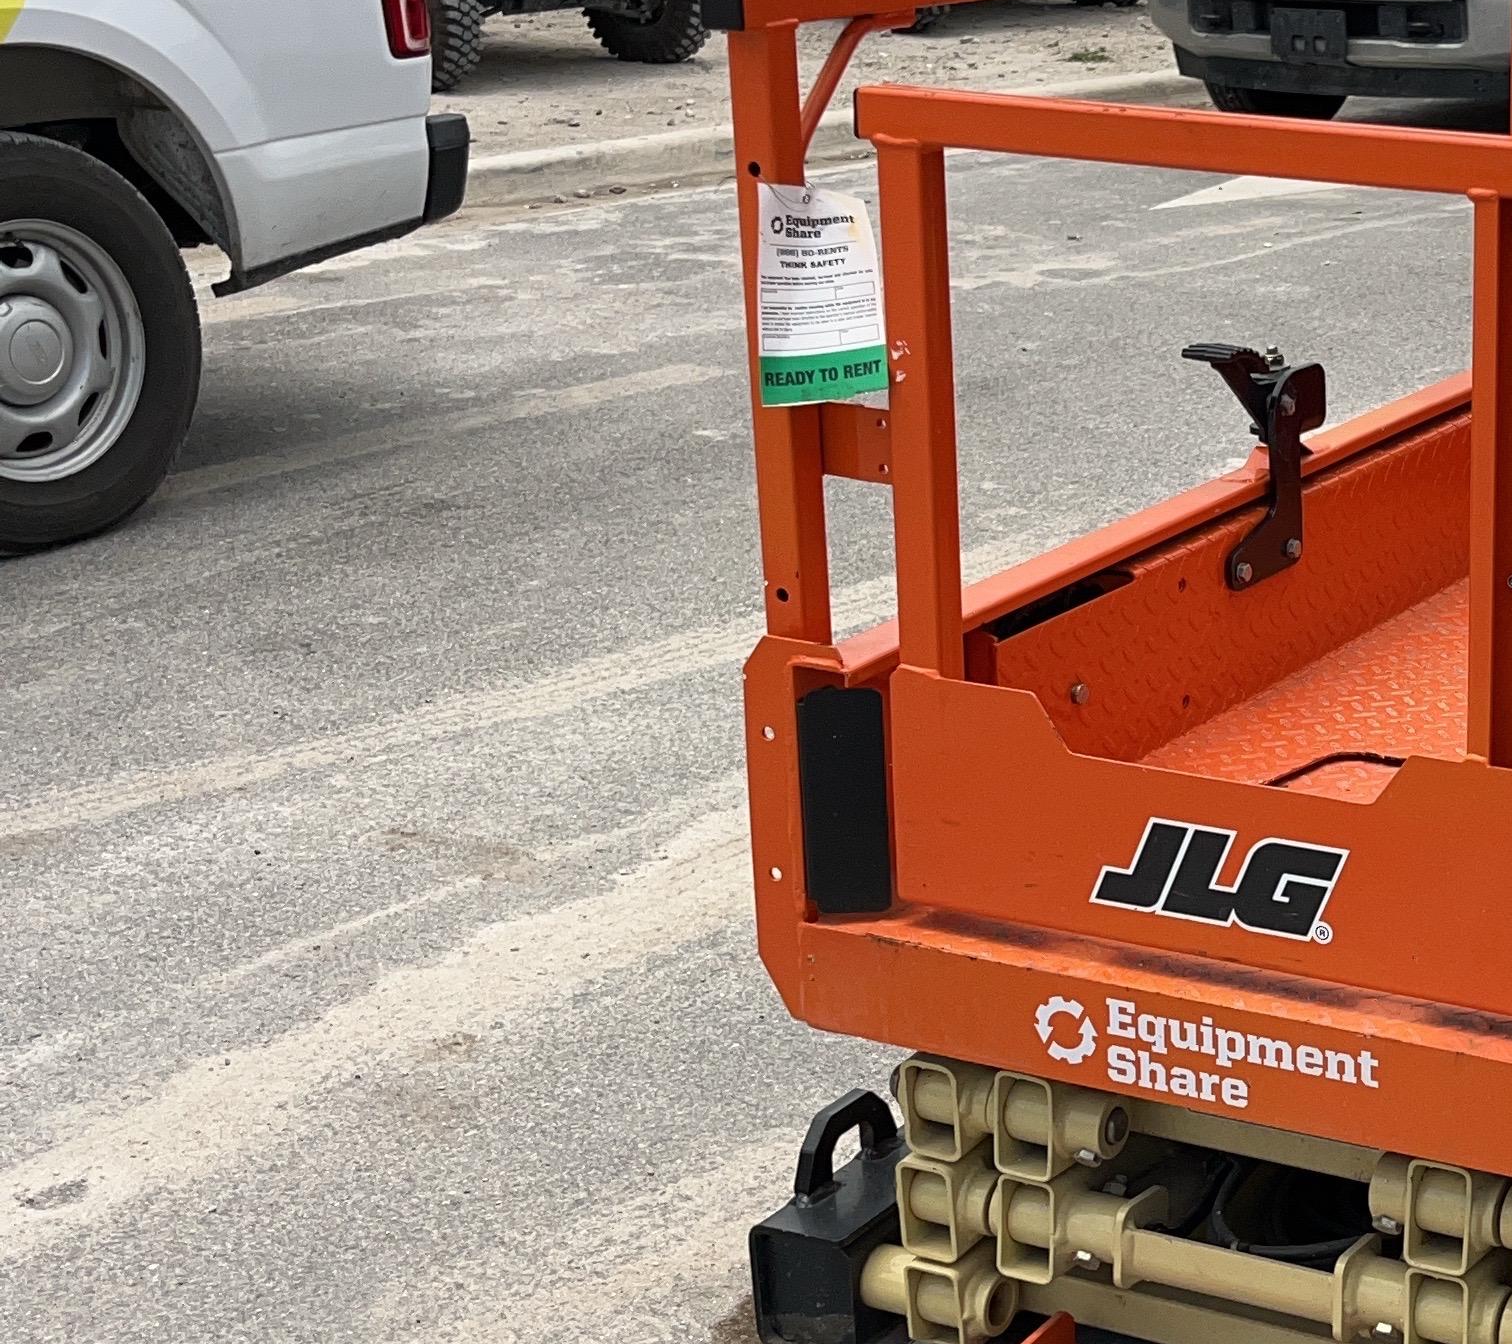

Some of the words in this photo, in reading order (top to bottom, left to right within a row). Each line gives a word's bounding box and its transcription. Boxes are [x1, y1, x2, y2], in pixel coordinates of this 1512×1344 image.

[785, 214, 855, 229] Equipment
[785, 227, 822, 239] Share
[780, 260, 807, 269] THINK
[810, 258, 845, 268] SAFETY
[764, 369, 815, 387] READY
[819, 367, 838, 383] TO
[843, 359, 882, 379] RENT
[1089, 816, 1350, 943] JLG
[1105, 997, 1380, 1089] Equipment
[1106, 1044, 1250, 1109] Share
